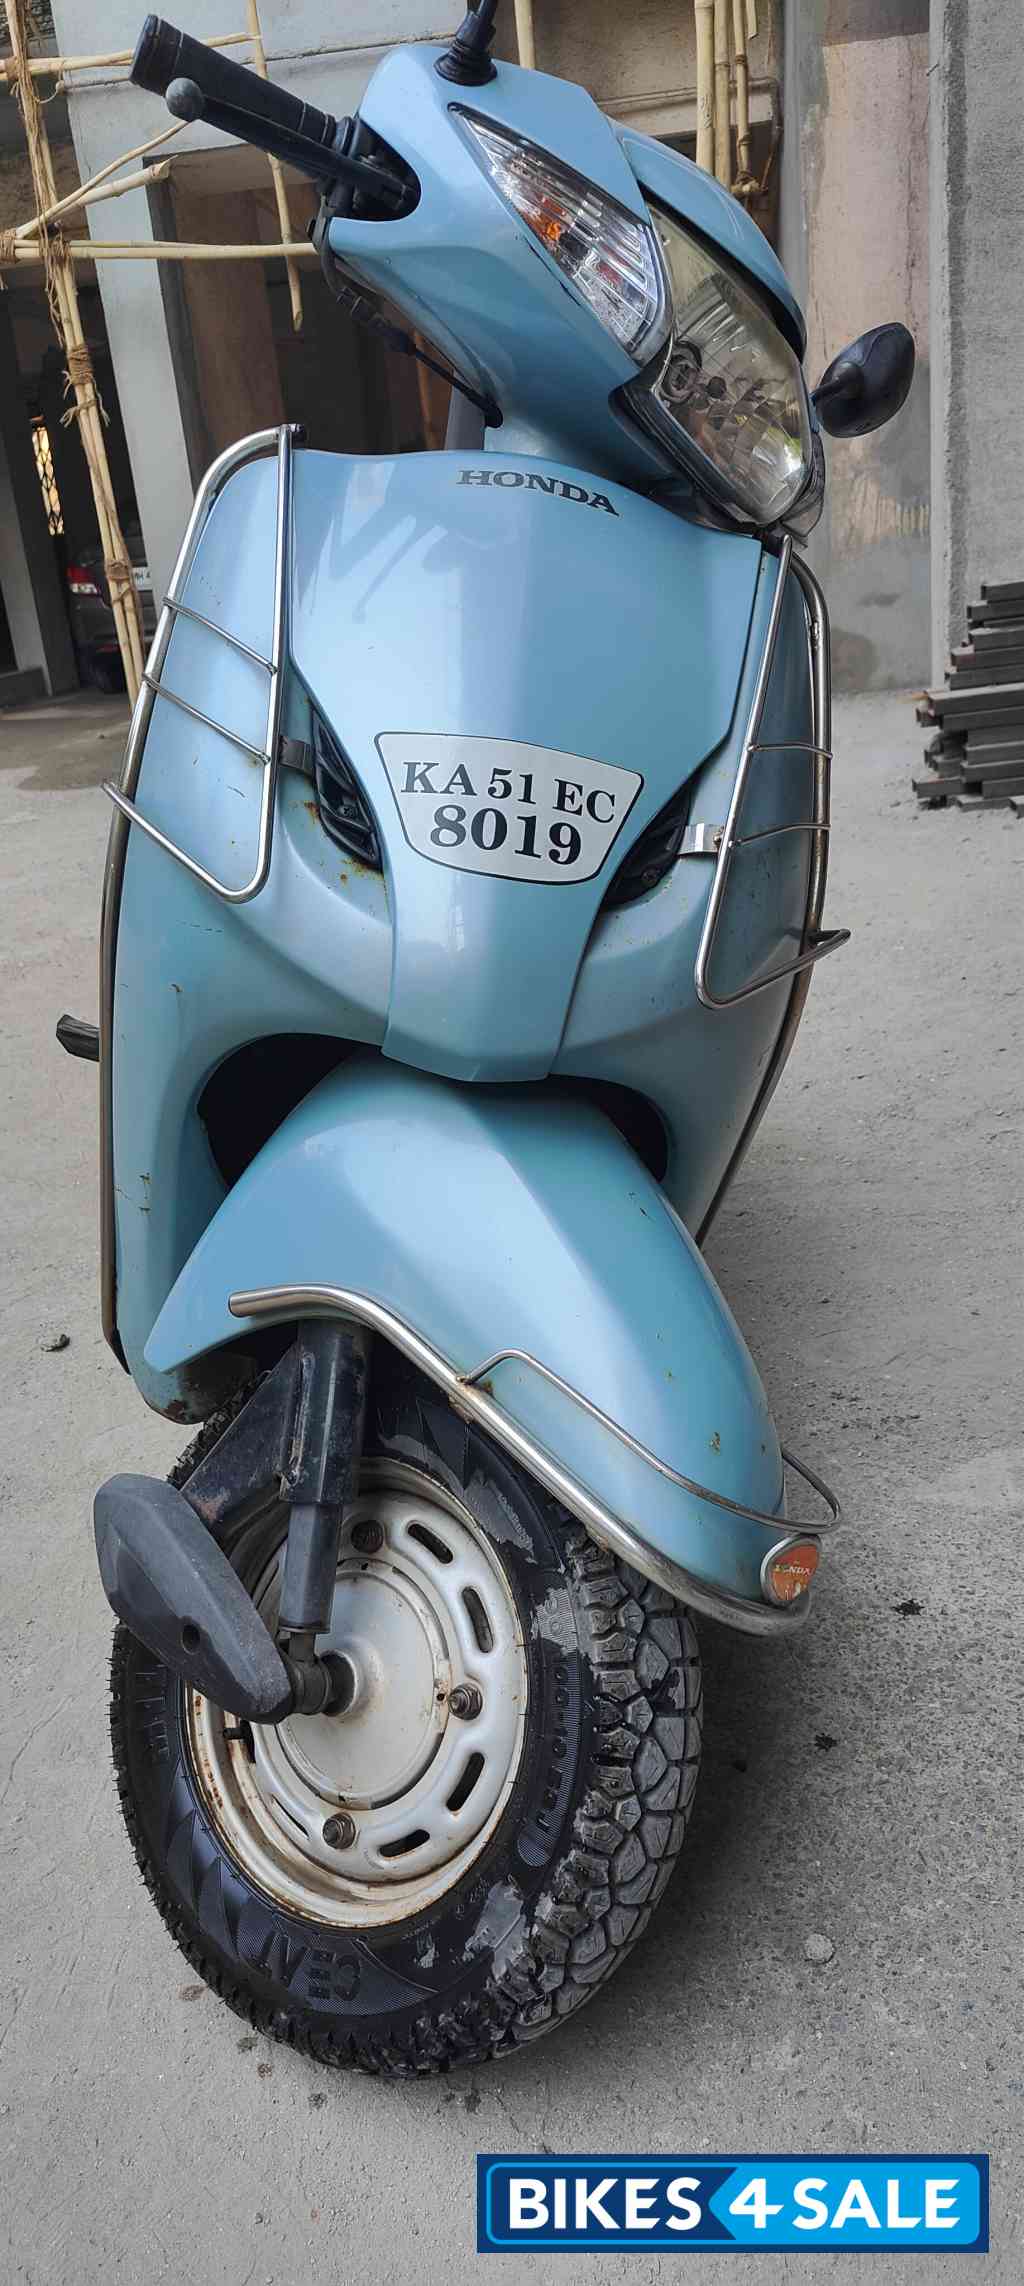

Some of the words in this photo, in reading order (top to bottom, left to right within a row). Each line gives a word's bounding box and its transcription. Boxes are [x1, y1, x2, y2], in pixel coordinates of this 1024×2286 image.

[456, 470, 619, 516] HONDA
[400, 761, 477, 796] KA
[487, 767, 536, 805] 51
[552, 778, 615, 823] EC
[430, 804, 582, 865] 8019
